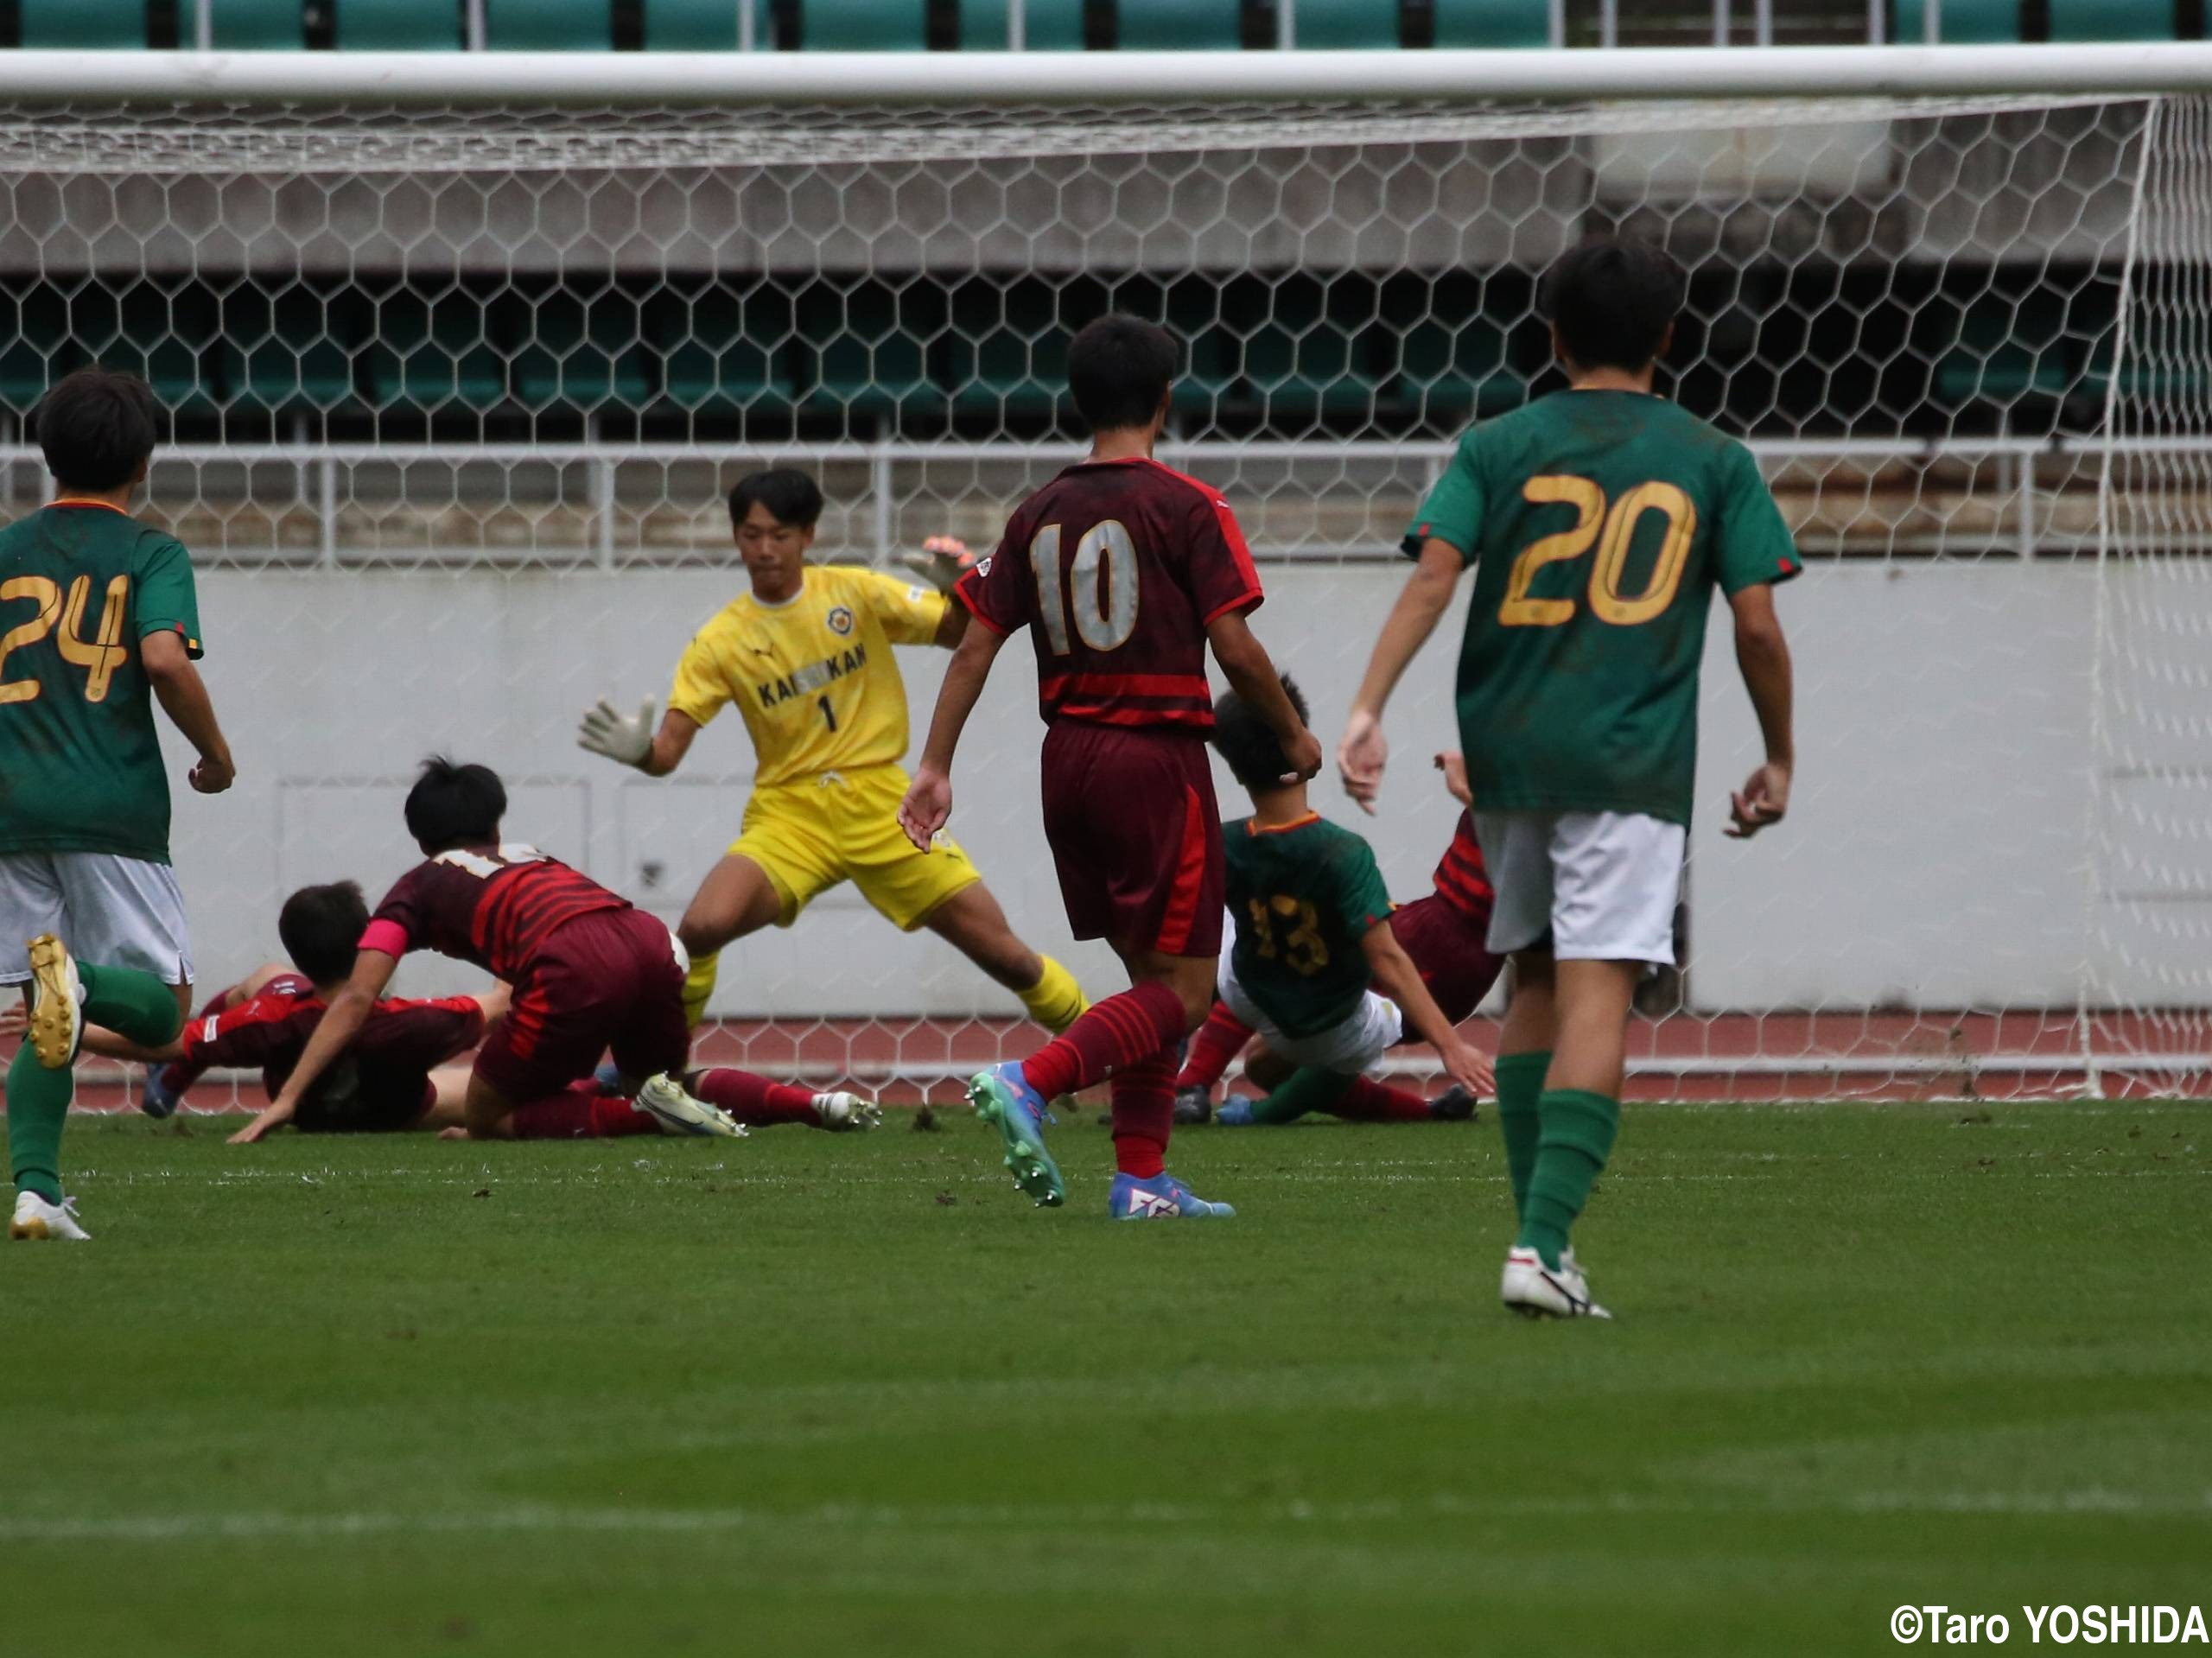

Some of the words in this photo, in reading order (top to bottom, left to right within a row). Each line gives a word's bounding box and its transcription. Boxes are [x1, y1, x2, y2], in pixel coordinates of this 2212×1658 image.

[1029, 519, 1139, 656] 10
[1497, 474, 1697, 626] 20
[0, 575, 127, 703] 24
[758, 643, 867, 708] KAIKAN
[817, 695, 837, 732] 1
[1249, 895, 1328, 976] 13
